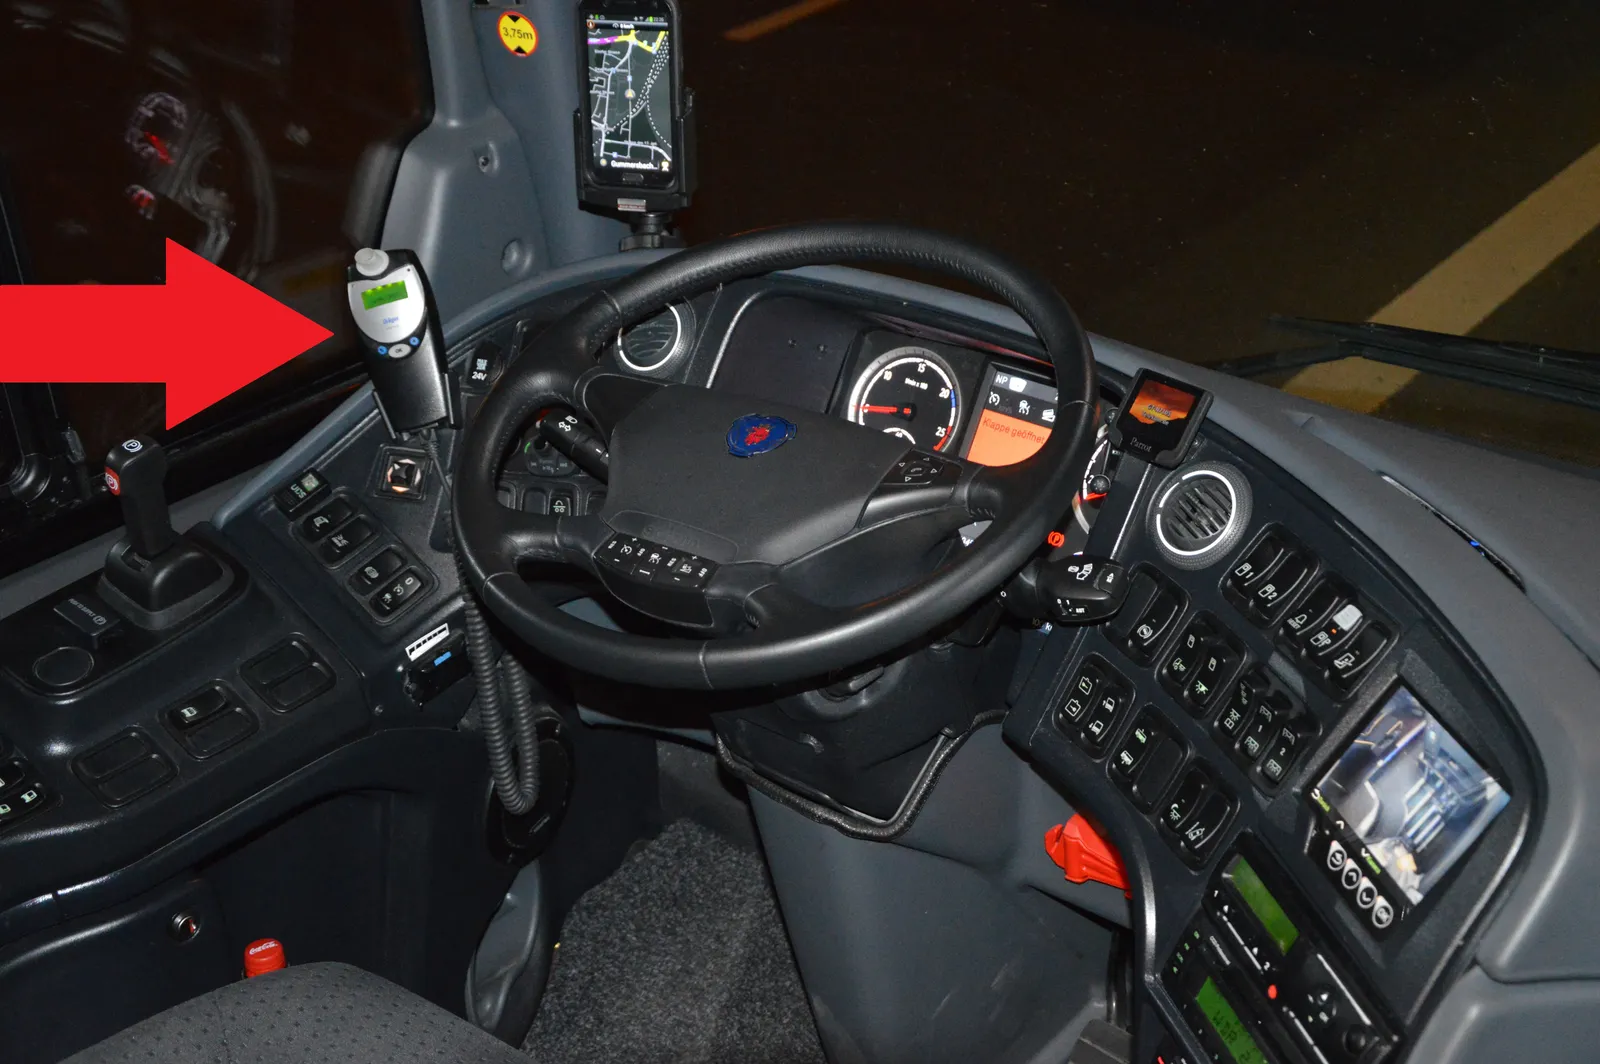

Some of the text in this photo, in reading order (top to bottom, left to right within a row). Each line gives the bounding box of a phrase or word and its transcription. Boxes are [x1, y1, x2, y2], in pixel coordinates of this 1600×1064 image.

[502, 26, 534, 41] 3,75m
[917, 363, 927, 373] 15
[883, 370, 892, 381] 10
[995, 374, 1009, 385] NP
[938, 387, 950, 399] 20
[935, 426, 946, 437] 25
[982, 417, 1046, 445] Klappe geöffnet
[1129, 436, 1153, 453] Parrot
[1279, 747, 1286, 757] 2
